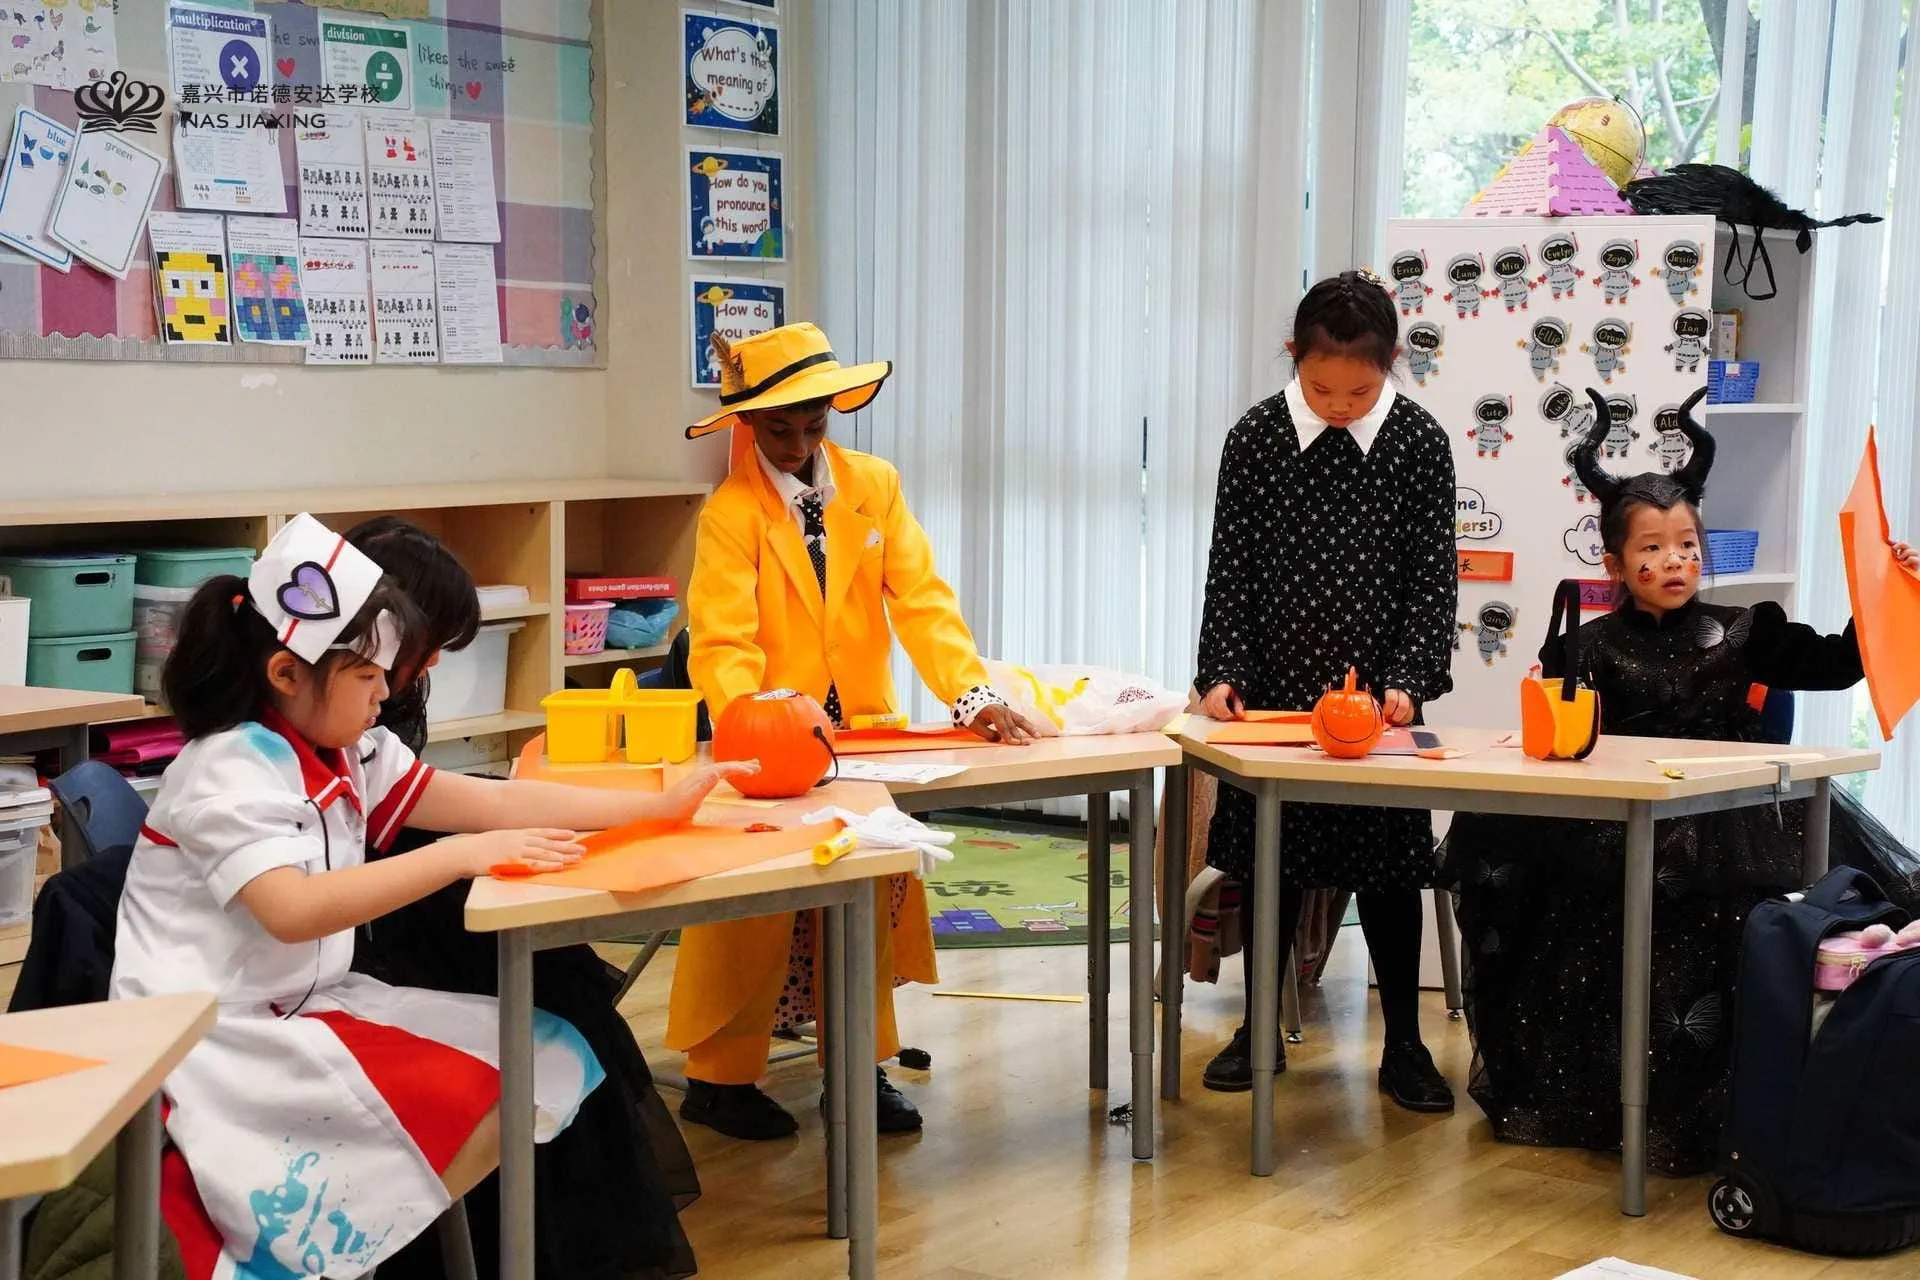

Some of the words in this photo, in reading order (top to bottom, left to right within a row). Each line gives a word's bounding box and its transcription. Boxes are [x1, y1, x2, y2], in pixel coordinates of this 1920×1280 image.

[174, 13, 252, 32] multiplication
[327, 26, 365, 41] division
[418, 43, 448, 65] likes
[457, 51, 478, 71] the
[701, 46, 746, 63] What's
[428, 76, 464, 99] things
[707, 73, 753, 94] meaning
[756, 78, 768, 92] of
[47, 128, 66, 146] blue
[104, 142, 134, 161] green
[736, 173, 749, 188] do
[717, 200, 766, 212] pronounce
[716, 216, 738, 233] this
[742, 219, 768, 234] word?
[1501, 262, 1520, 272] Mia
[716, 304, 748, 317] How
[754, 303, 768, 319] do
